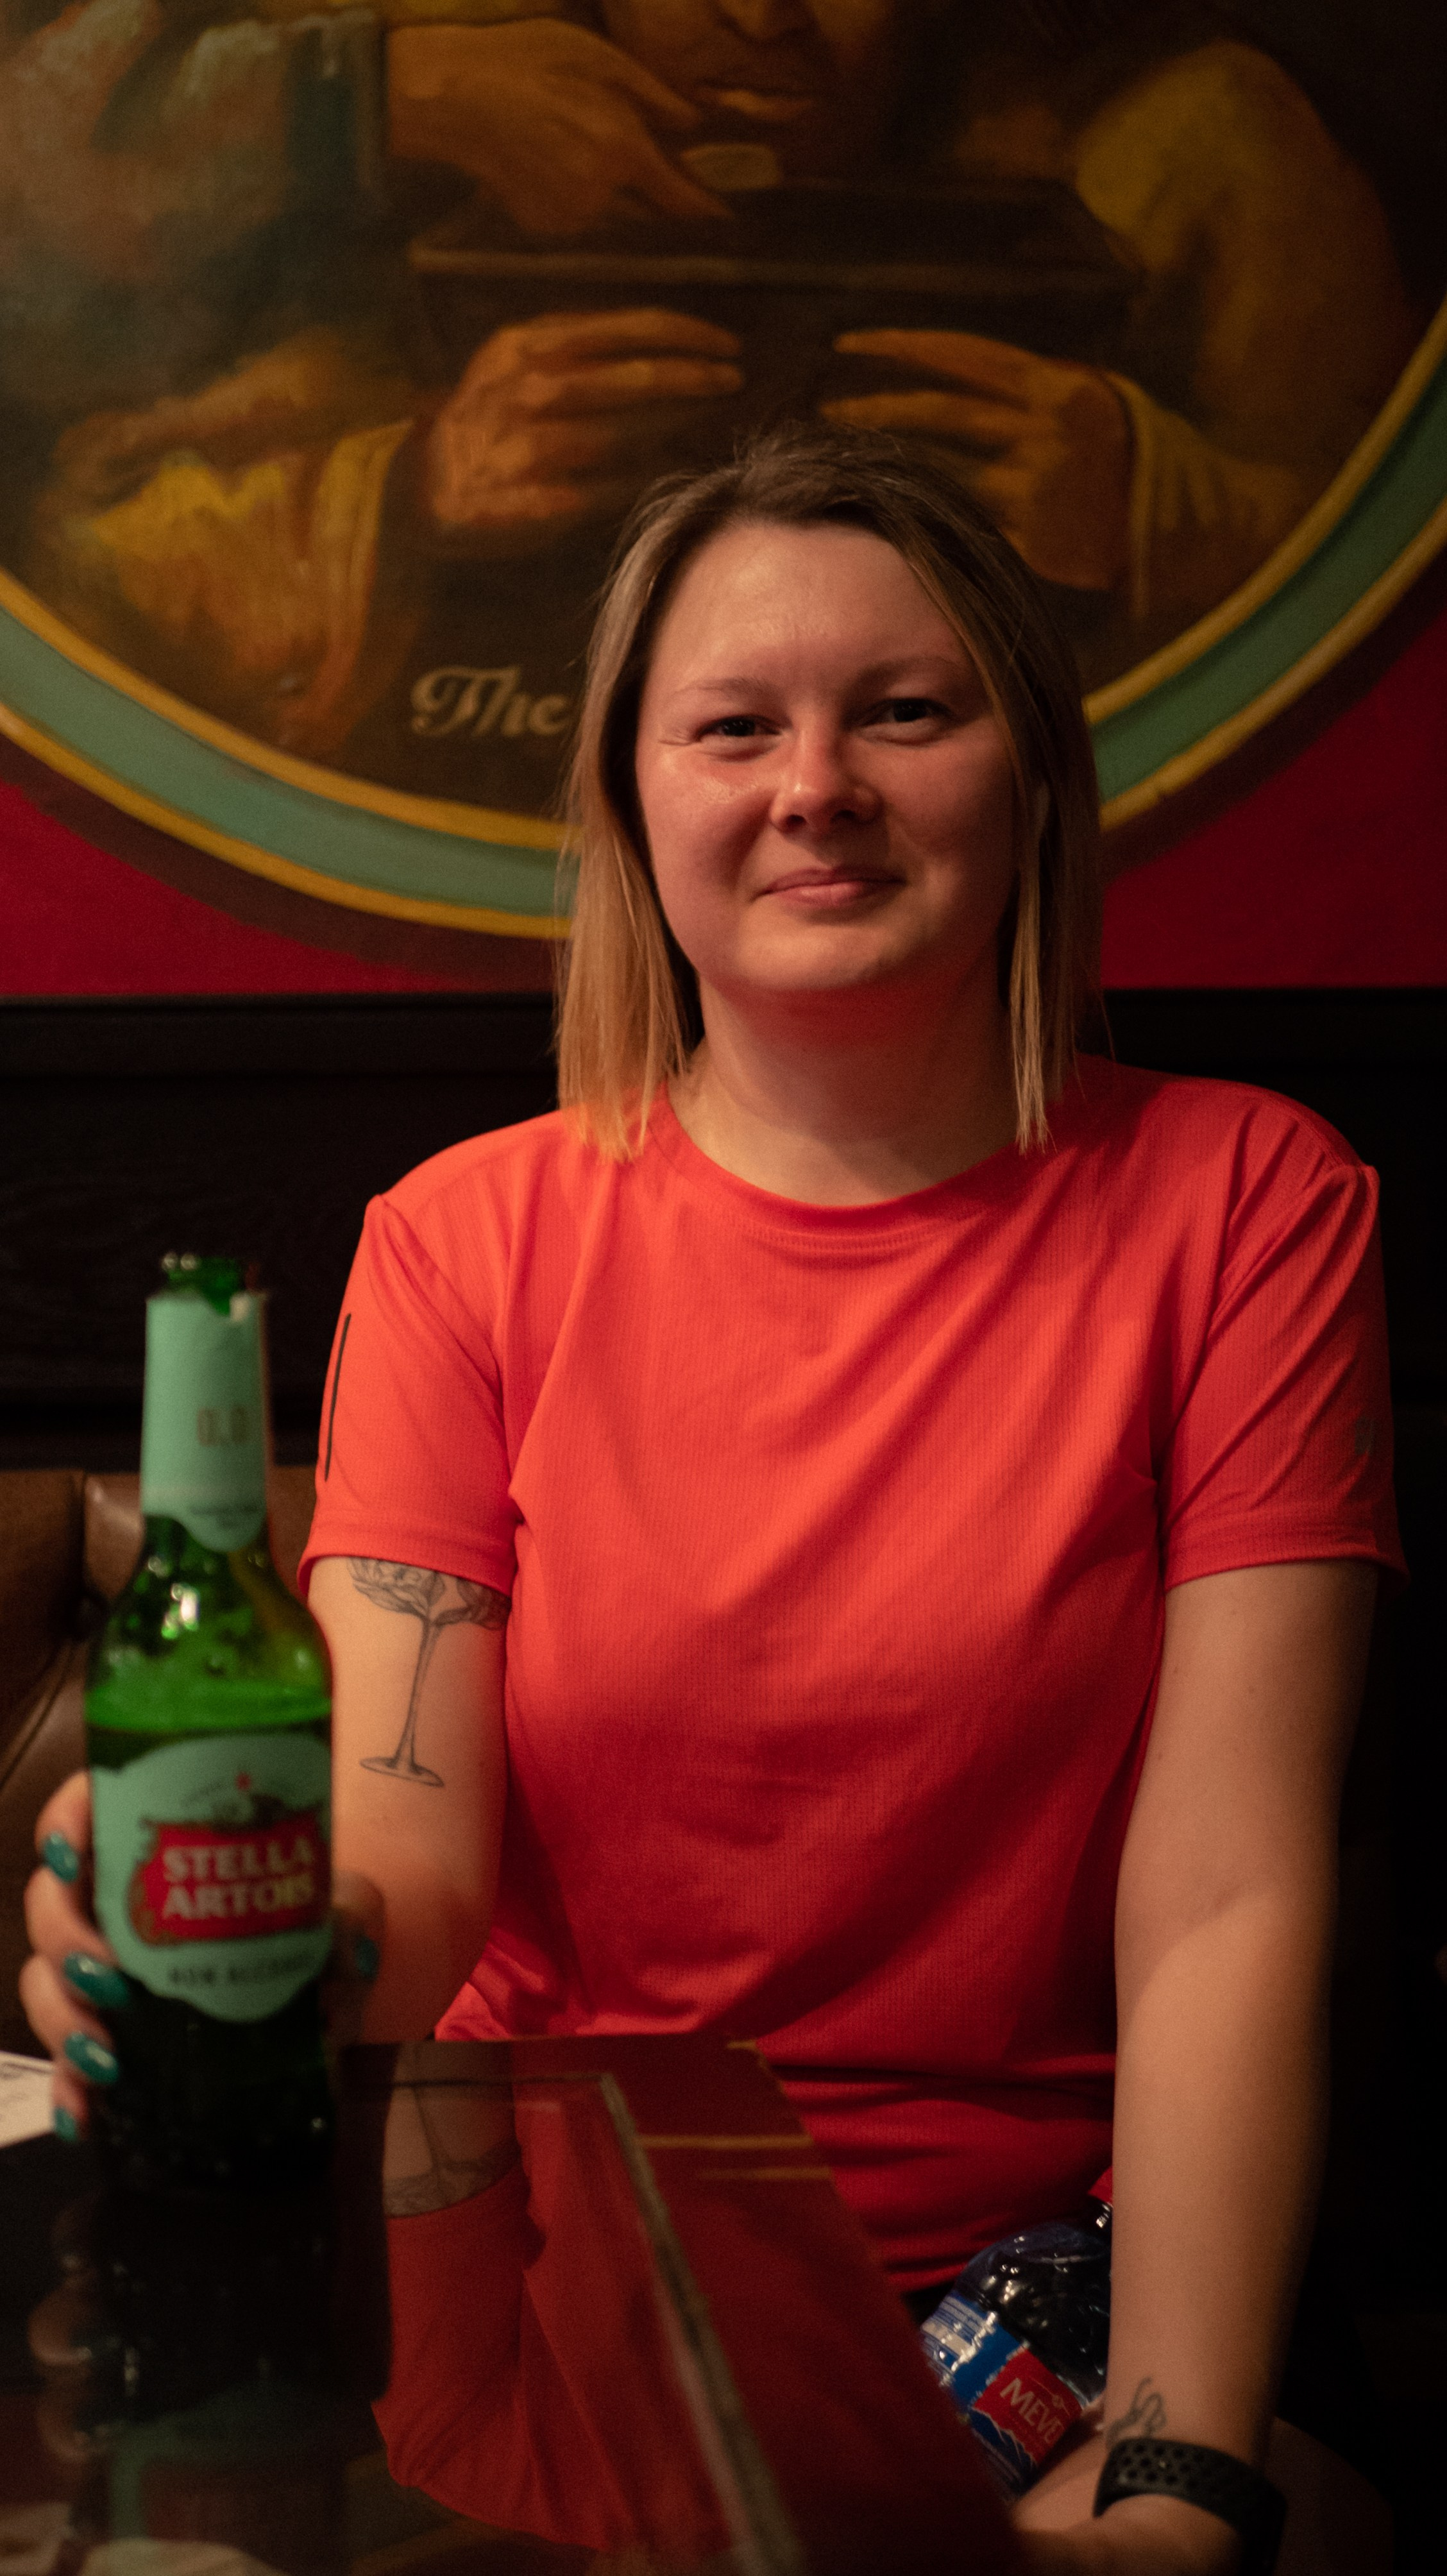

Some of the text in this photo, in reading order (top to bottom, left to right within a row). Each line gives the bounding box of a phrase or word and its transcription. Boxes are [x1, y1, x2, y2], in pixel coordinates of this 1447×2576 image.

[410, 664, 570, 738] The
[162, 1833, 314, 1884] STELLA
[161, 1872, 314, 1921] ARTOIS
